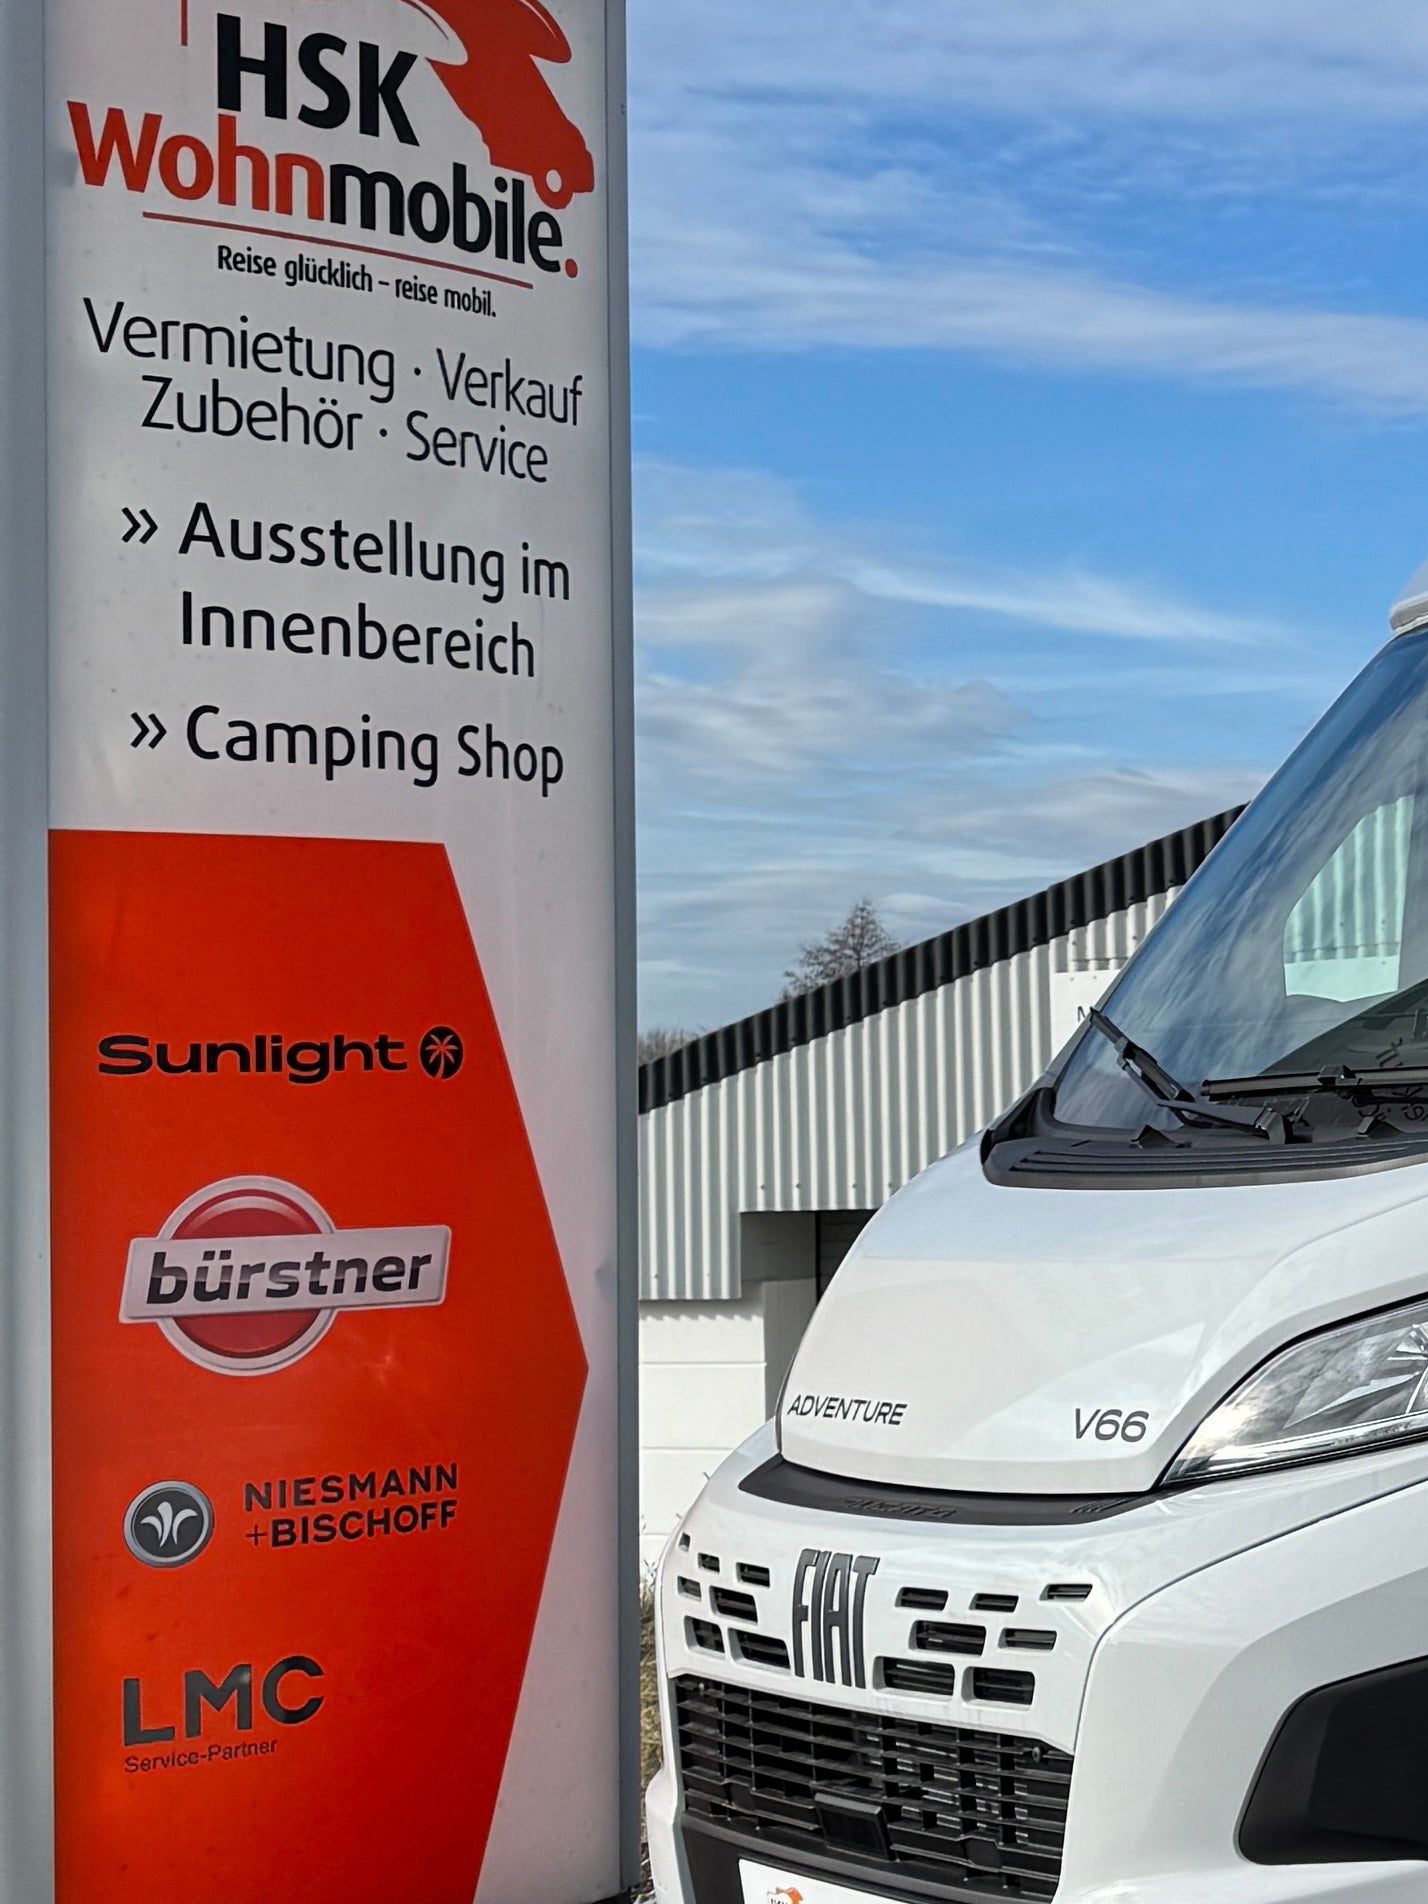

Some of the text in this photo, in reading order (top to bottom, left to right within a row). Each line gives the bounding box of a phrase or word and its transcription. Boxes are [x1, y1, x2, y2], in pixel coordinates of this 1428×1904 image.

[217, 13, 420, 146] HSK
[217, 245, 497, 317] Reise glücklich reise mobil.
[83, 297, 584, 427] Vermietung Verkauf
[141, 375, 549, 483] Zubehör Service
[178, 502, 570, 603] Ausstellung im
[181, 591, 535, 678] Innenbereich
[186, 704, 565, 797] Camping Shop
[98, 1033, 408, 1085] Sunlight
[146, 1249, 432, 1305] bürstner
[787, 1395, 908, 1426] ADVENTURE
[1074, 1408, 1150, 1443] V66
[245, 1463, 457, 1512] NIESMANN
[792, 1548, 881, 1689] FIAT
[123, 1655, 324, 1746] LMC
[124, 1739, 278, 1774] Service-Partner
